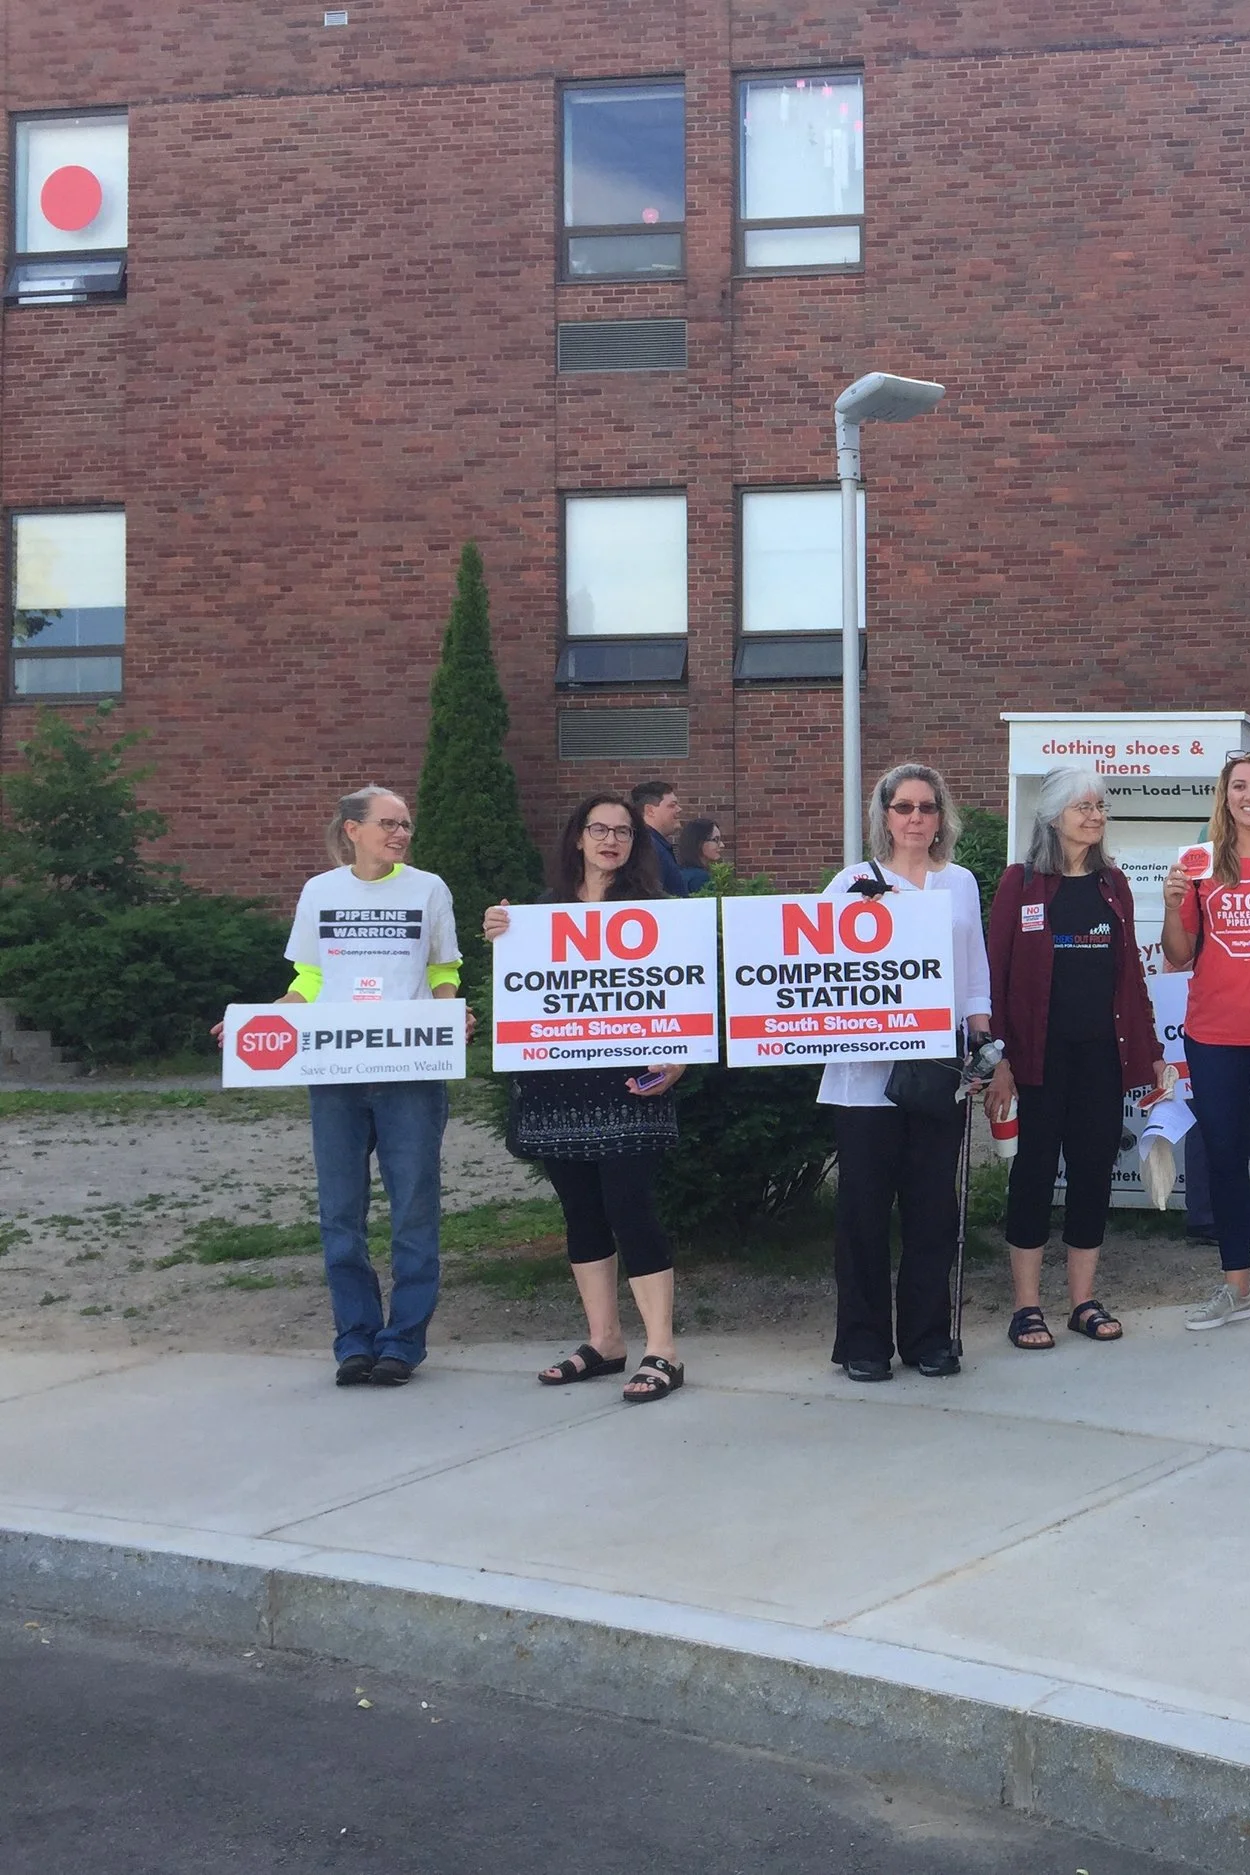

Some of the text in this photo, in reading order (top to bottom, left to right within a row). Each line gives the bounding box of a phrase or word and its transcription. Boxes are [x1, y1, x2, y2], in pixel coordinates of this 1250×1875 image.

[1042, 739, 1204, 759] clothing shoes &
[1095, 759, 1151, 774] linens
[1121, 863, 1168, 871] Donation
[335, 910, 407, 921] PIPELINE
[1026, 907, 1040, 915] NO
[333, 927, 407, 937] WARRIOR
[552, 908, 658, 962] NO
[782, 900, 893, 956] NO
[504, 965, 705, 992] COMPRESSOR
[735, 959, 942, 986] COMPRESSOR
[360, 979, 376, 987] NO
[543, 990, 666, 1014] STATION
[776, 984, 902, 1009] STATION
[530, 1018, 681, 1038] South Shore, MA
[765, 1013, 918, 1033] South Shore, MA
[242, 1031, 292, 1052] STOP
[302, 1031, 310, 1052] THE
[315, 1027, 454, 1050] PIPELINE
[758, 1039, 925, 1056] NOCompressor.com
[523, 1043, 688, 1061] NOCompressor.com
[300, 1060, 453, 1076] Save Our Common Wealth
